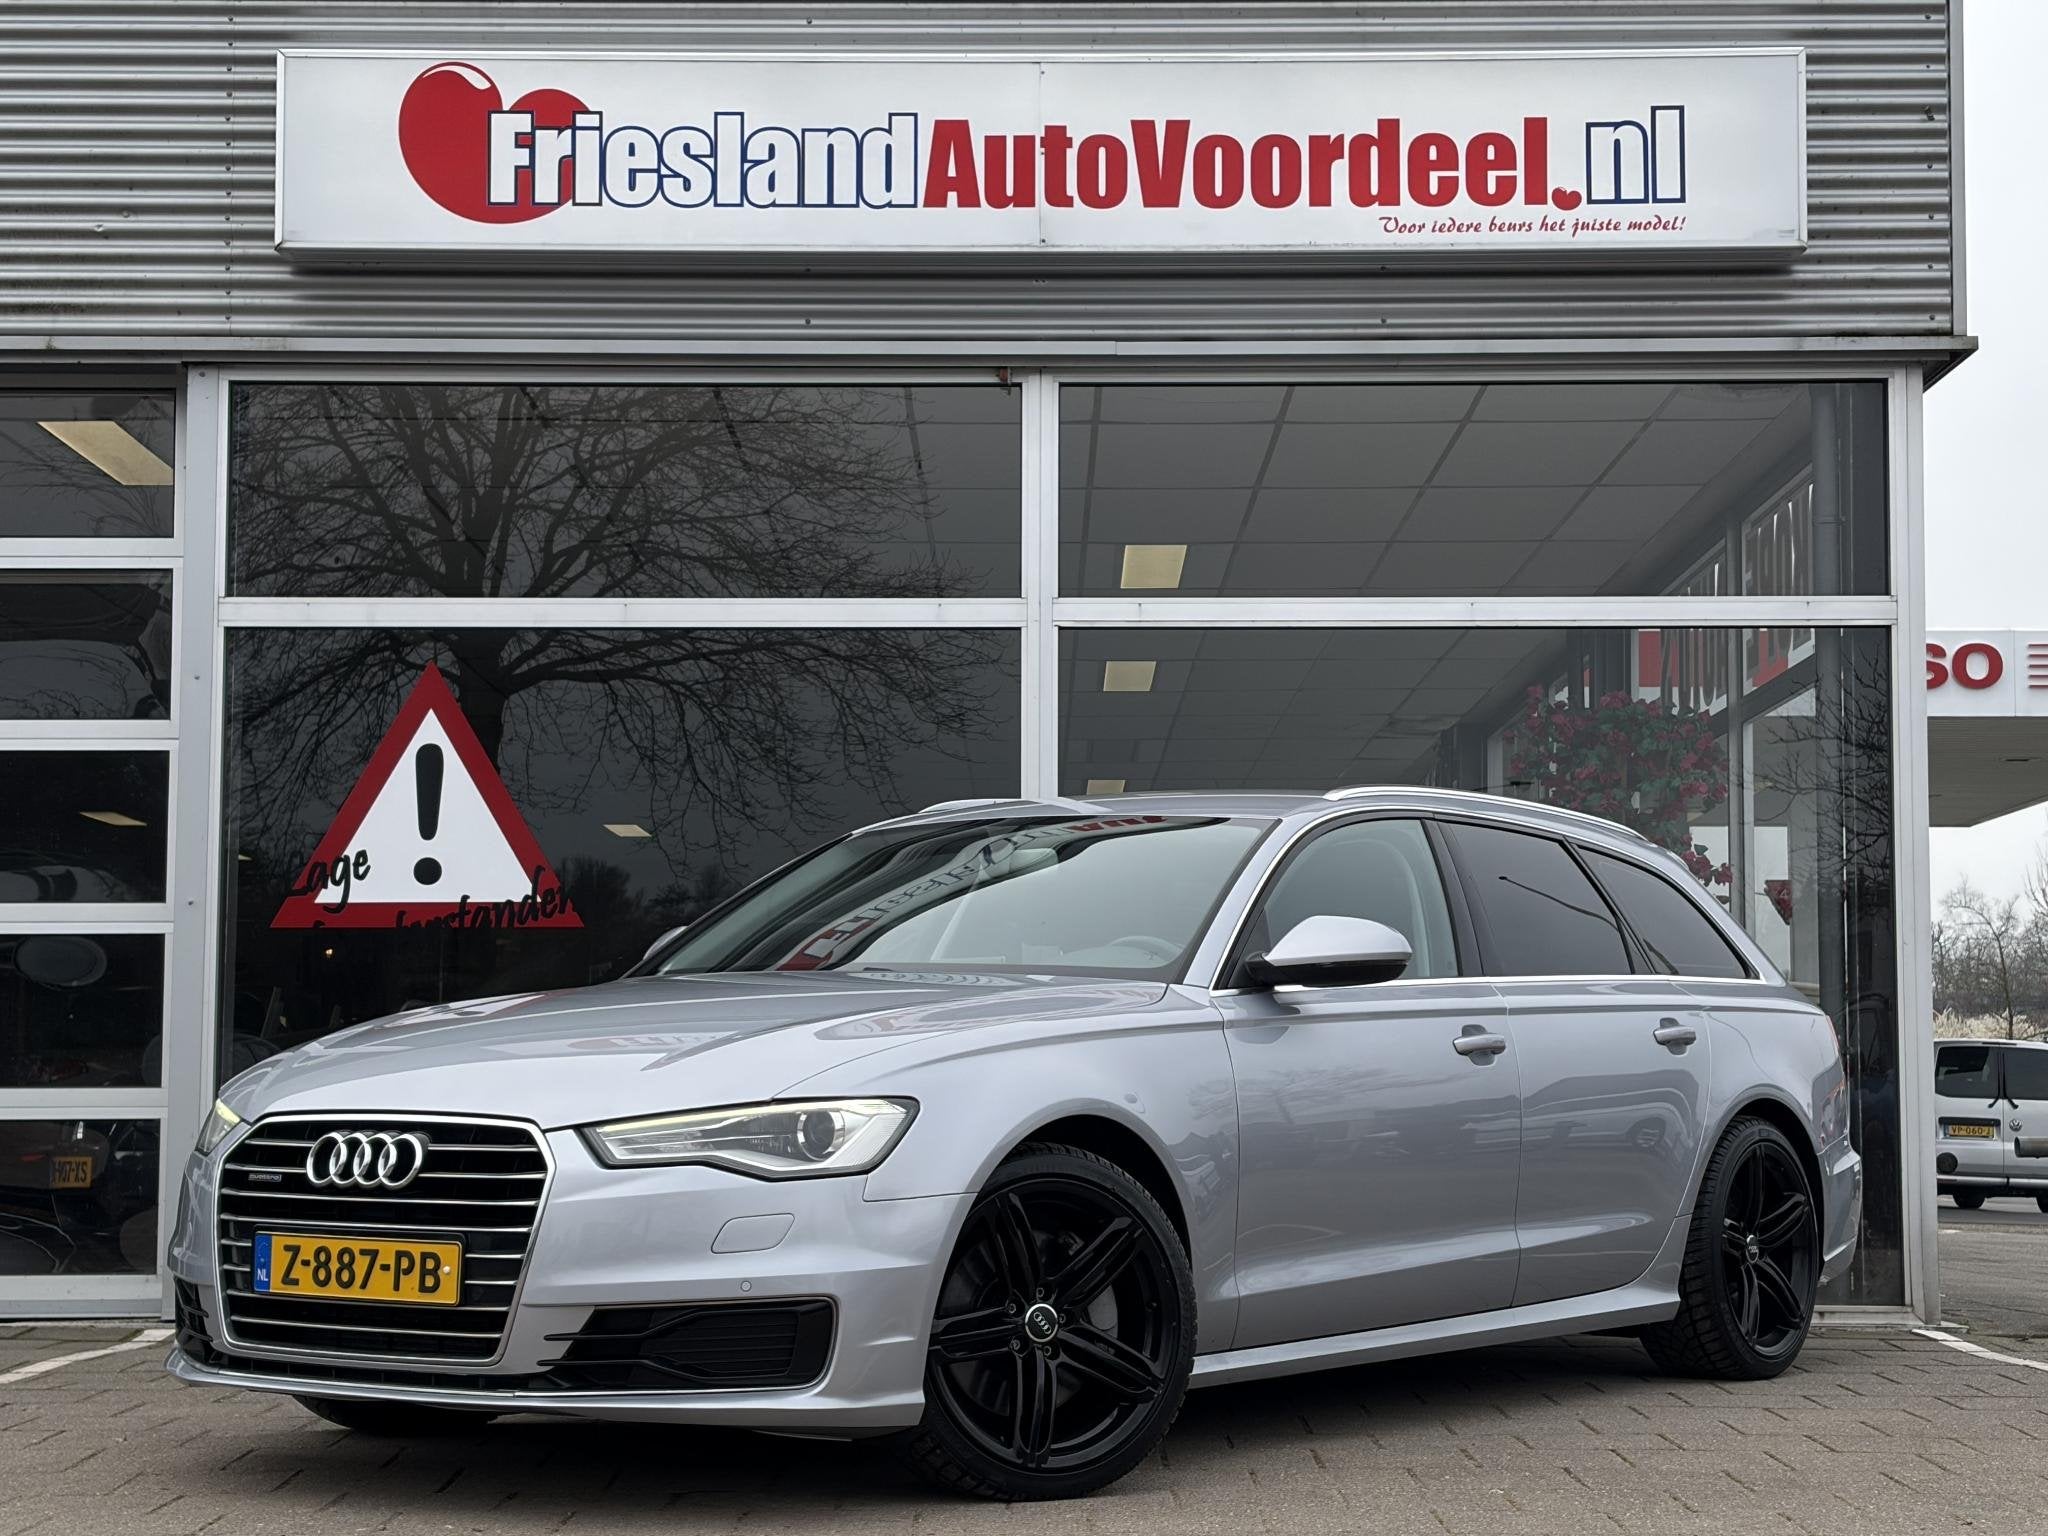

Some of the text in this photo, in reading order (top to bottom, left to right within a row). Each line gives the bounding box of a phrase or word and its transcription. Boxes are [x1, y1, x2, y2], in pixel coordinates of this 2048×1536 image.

[486, 105, 1687, 211] FrieslandAutoVoordeel.nl
[1378, 214, 1687, 238] Voor iedere beurs het juiste model!
[257, 1268, 269, 1282] NL
[280, 1243, 441, 1294] Z-887-PB
